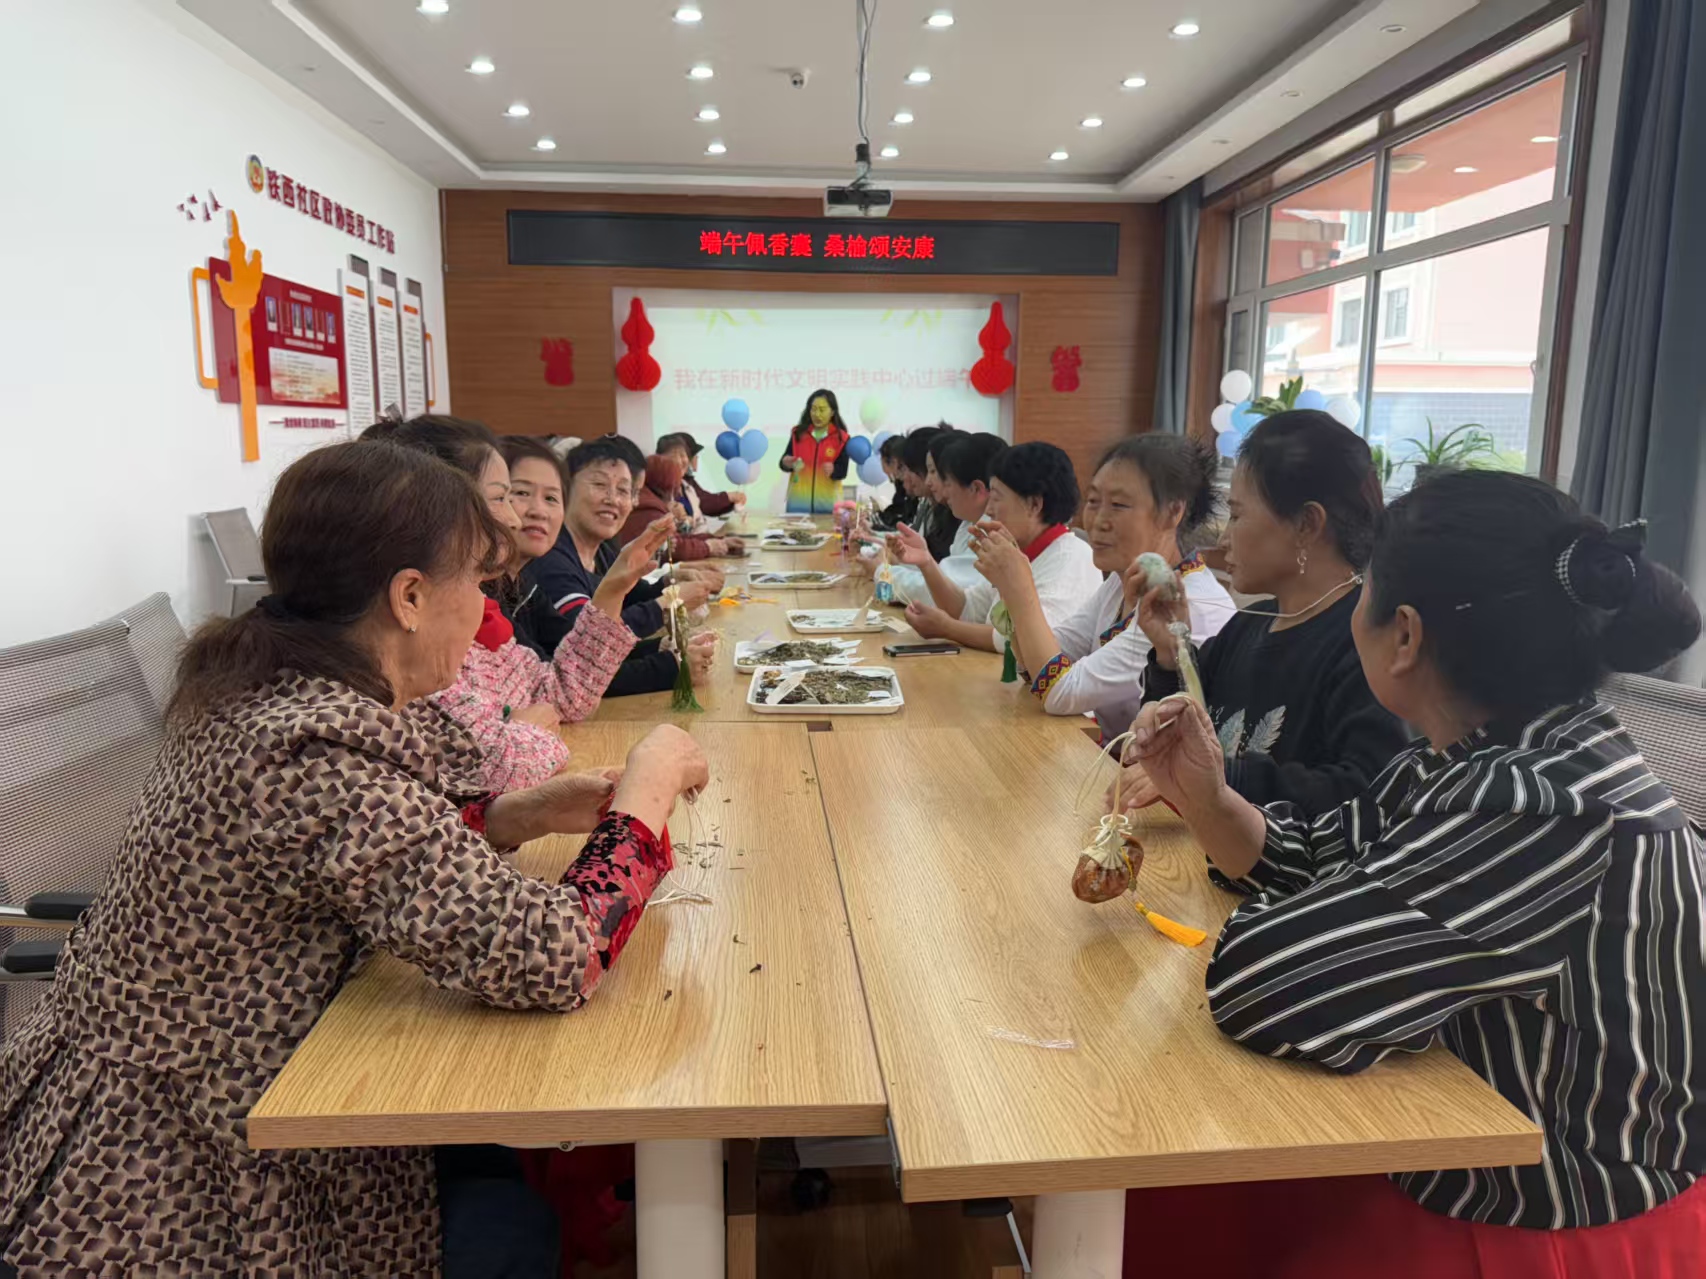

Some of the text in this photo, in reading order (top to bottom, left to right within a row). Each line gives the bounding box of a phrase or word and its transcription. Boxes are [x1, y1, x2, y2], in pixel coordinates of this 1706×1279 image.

[699, 230, 935, 260] 端午佩香囊 桑榆颂安康
